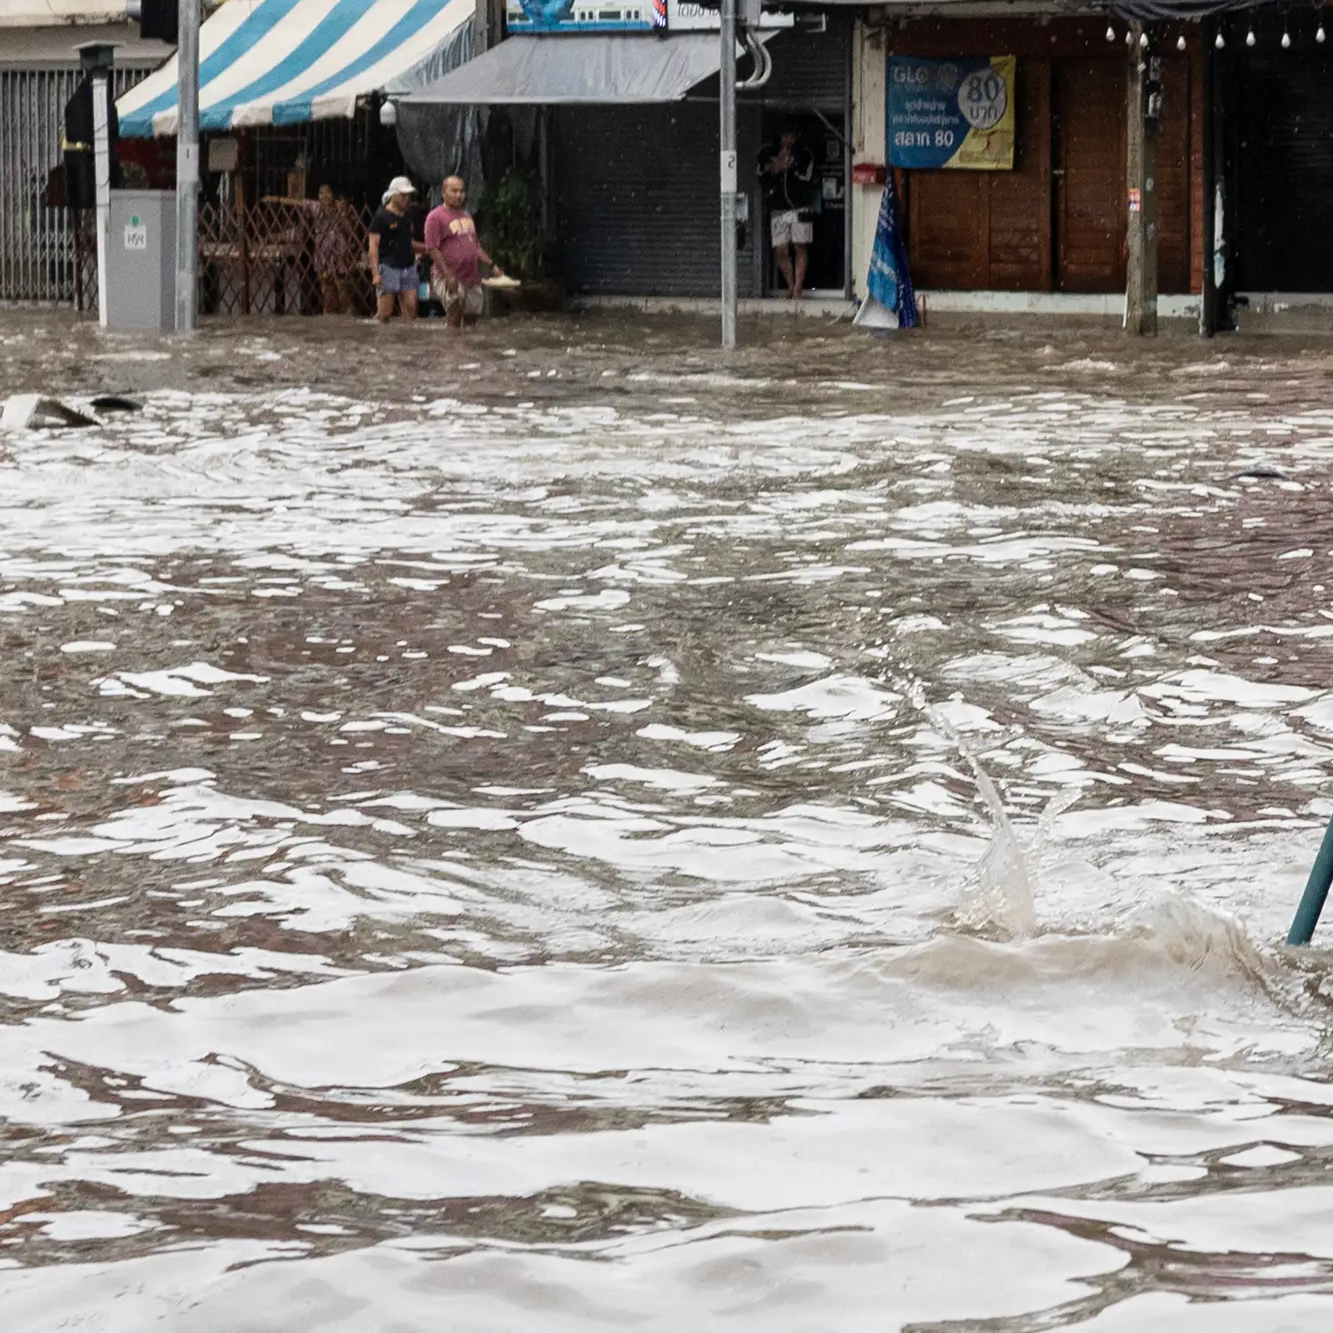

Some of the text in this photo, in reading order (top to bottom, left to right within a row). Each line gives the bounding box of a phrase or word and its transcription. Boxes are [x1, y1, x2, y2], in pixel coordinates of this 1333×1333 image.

[894, 66, 928, 83] GLO
[967, 75, 999, 103] 80
[894, 129, 954, 148] สลาก 80
